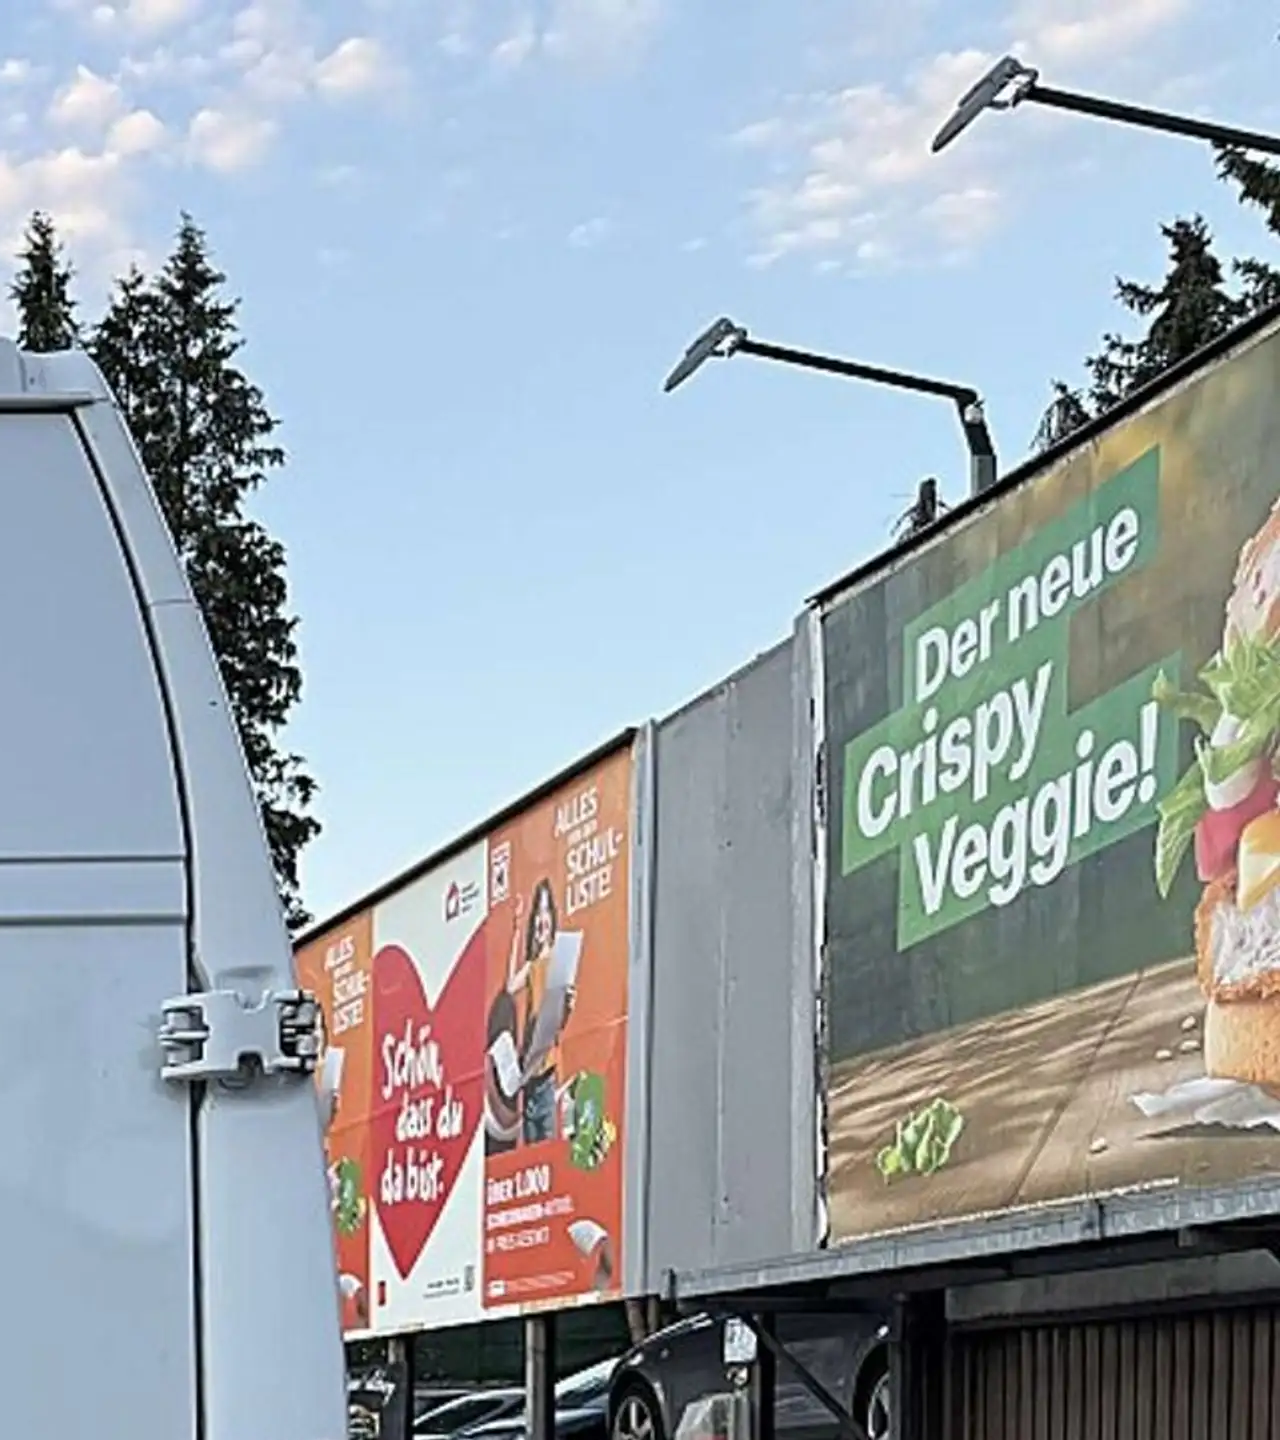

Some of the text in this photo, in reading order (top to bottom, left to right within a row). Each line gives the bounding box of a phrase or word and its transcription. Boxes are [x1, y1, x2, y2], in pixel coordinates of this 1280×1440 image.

[915, 507, 1139, 702] Der neue
[857, 660, 1054, 838] Crispy
[554, 787, 598, 838] ALLES
[913, 701, 1159, 917] Veggie!
[382, 1018, 444, 1100] Schön,
[396, 1084, 464, 1142] dass du
[381, 1146, 445, 1204] da bist.
